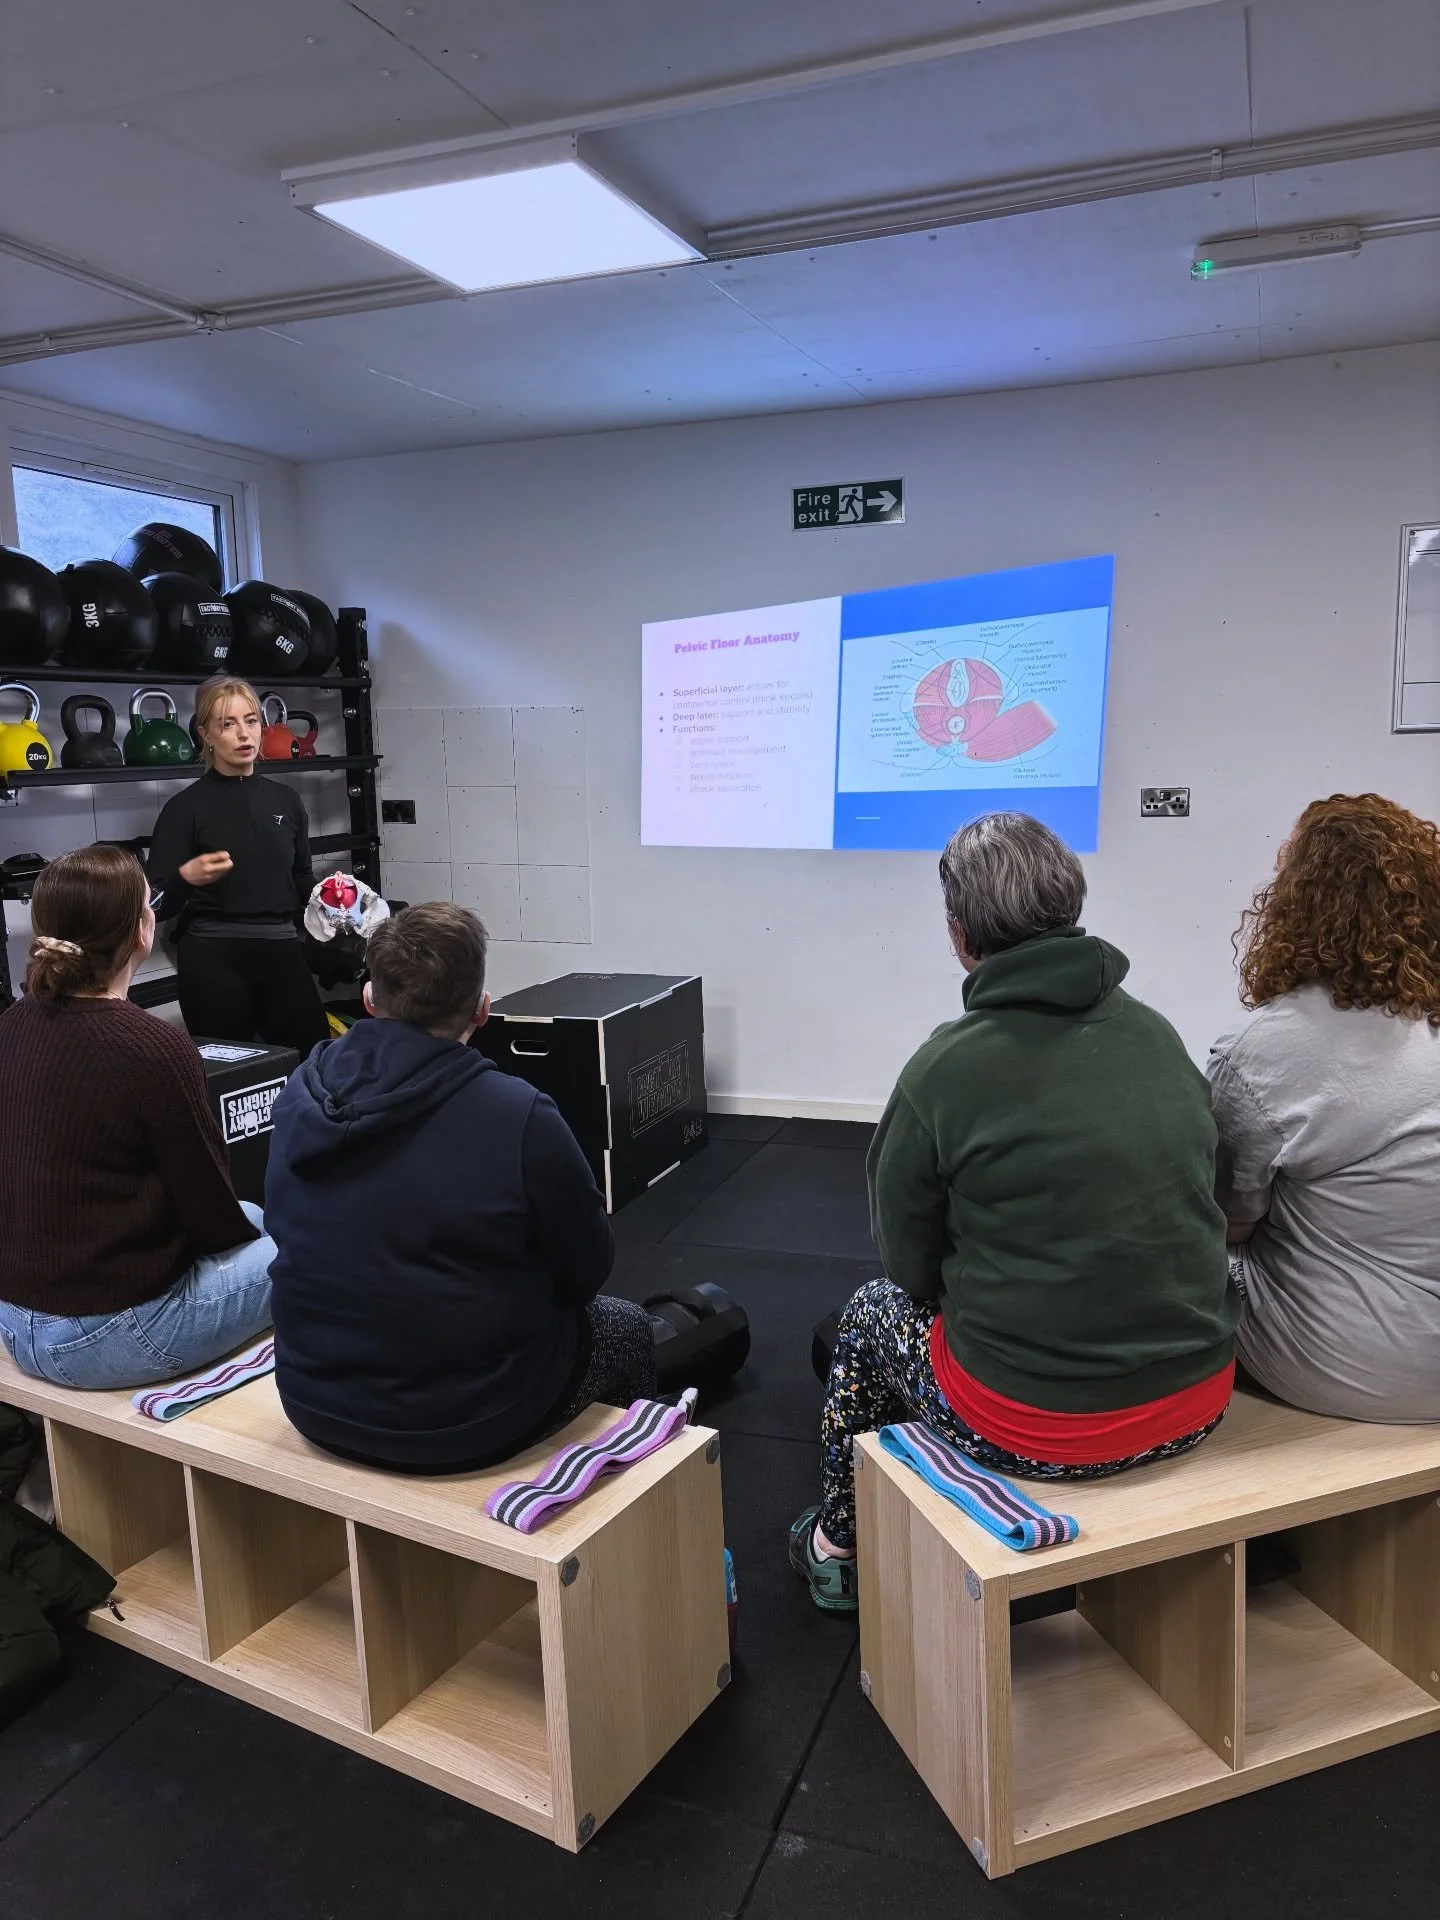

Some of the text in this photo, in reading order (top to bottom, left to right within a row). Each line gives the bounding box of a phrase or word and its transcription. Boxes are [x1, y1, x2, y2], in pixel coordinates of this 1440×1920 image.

[797, 493, 831, 507] Fire
[798, 509, 830, 523] exit
[82, 602, 101, 629] 3KG
[275, 635, 295, 655] 6KG
[674, 631, 800, 654] Pelvic Floor Anatomy
[673, 687, 718, 698] Superficial
[719, 683, 745, 695] layer:
[776, 679, 790, 688] for
[673, 713, 695, 723] Deep
[720, 709, 755, 720] support
[756, 707, 774, 715] and
[776, 703, 811, 715] stability
[673, 725, 716, 735] Functions:
[28, 753, 47, 761] 20KG
[227, 1086, 281, 1118] WEIGHTS
